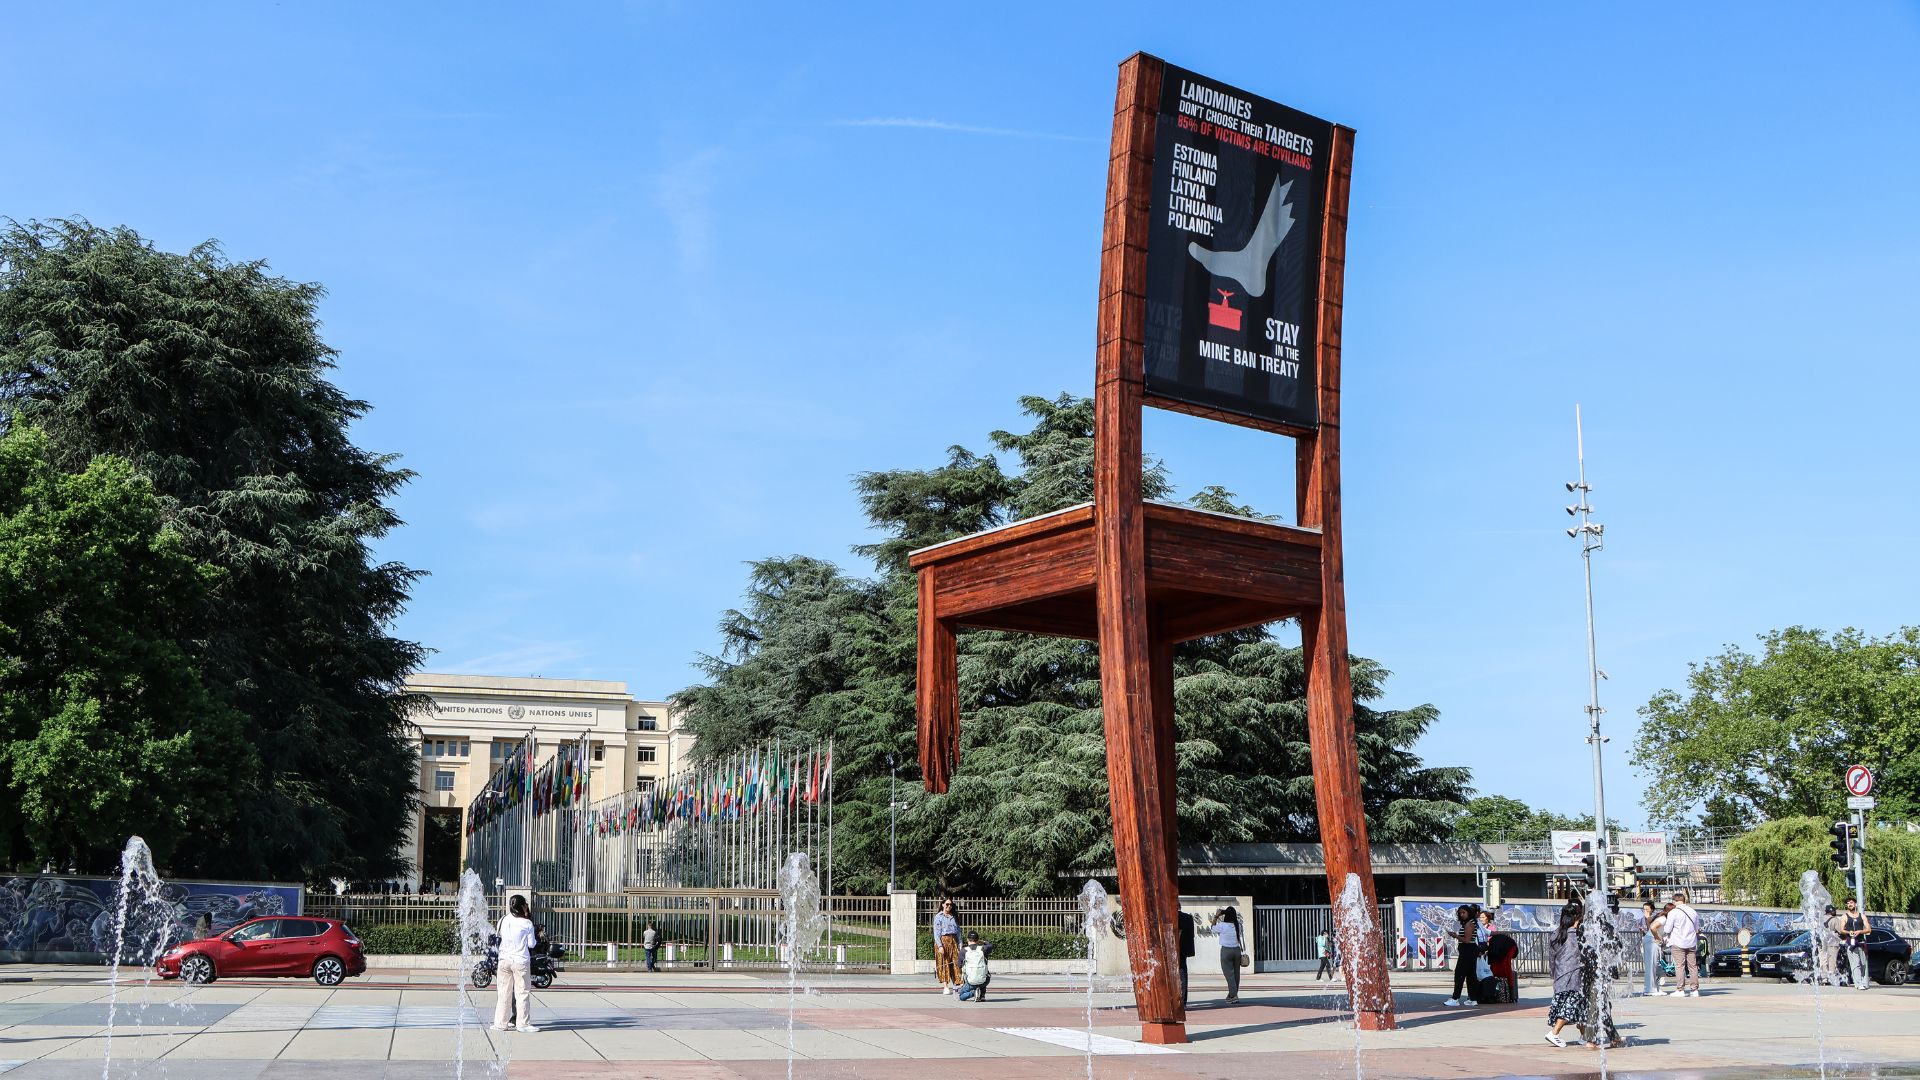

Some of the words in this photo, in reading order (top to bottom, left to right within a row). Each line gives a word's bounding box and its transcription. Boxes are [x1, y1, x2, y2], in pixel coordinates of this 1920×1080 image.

[1181, 80, 1251, 119] LANDMINES
[1179, 100, 1204, 118] DON'T
[1206, 109, 1238, 130] CHOOSE
[1241, 120, 1262, 138] THEIR
[1266, 124, 1313, 155] TARGETS
[1174, 143, 1217, 170] ESTONIA
[1178, 116, 1197, 131] 85%
[1201, 123, 1212, 135] OF
[1216, 127, 1250, 150] VICTIMS
[1253, 141, 1269, 155] ARE
[1272, 147, 1311, 170] CIVILIANS
[1172, 161, 1216, 186] FINLAND
[1171, 177, 1206, 201] LATVIA
[1170, 194, 1222, 223] LITHUANIA
[1168, 211, 1213, 237] POLAND:
[1266, 318, 1299, 346] STAY
[1200, 340, 1230, 362] MINE
[1234, 348, 1256, 368] BAN
[1260, 355, 1299, 379] TREATY
[1275, 344, 1284, 357] IN
[1285, 347, 1299, 361] THE
